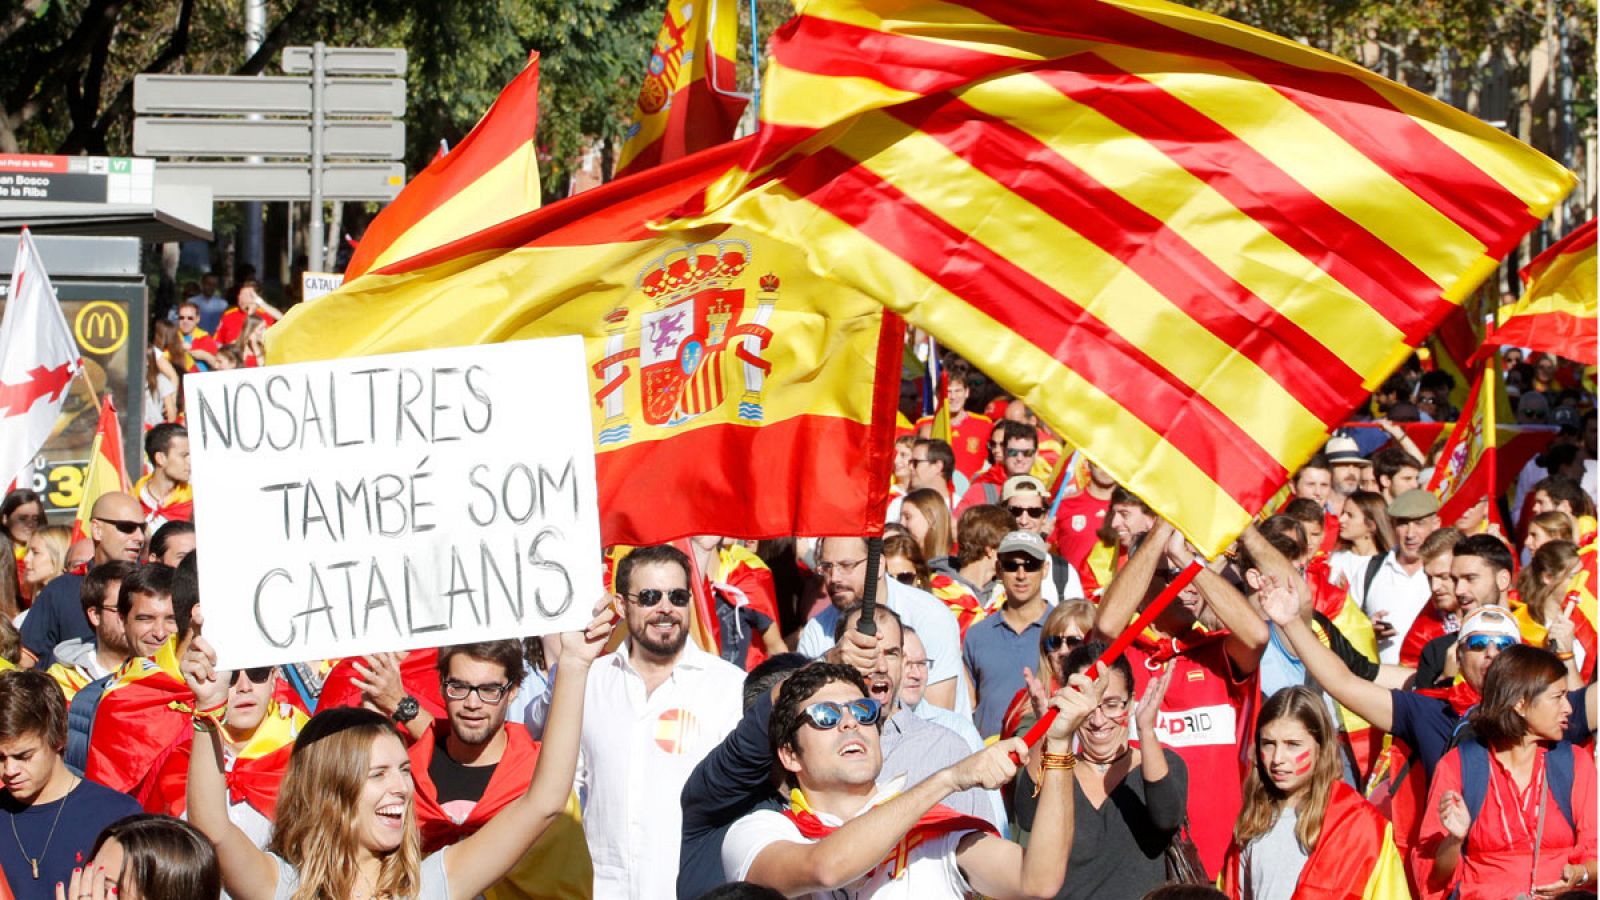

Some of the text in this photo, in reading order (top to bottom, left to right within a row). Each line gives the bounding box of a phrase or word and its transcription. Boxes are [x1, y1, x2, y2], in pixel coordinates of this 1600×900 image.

[113, 160, 128, 171] V7
[0, 175, 50, 186] an Bosco
[11, 186, 21, 197] la
[23, 187, 48, 198] Riba
[197, 364, 493, 452] NOSALTRES
[260, 455, 580, 541] TAMBÉ SOM
[253, 525, 575, 648] CATALANS
[1153, 713, 1212, 734] ADRID
